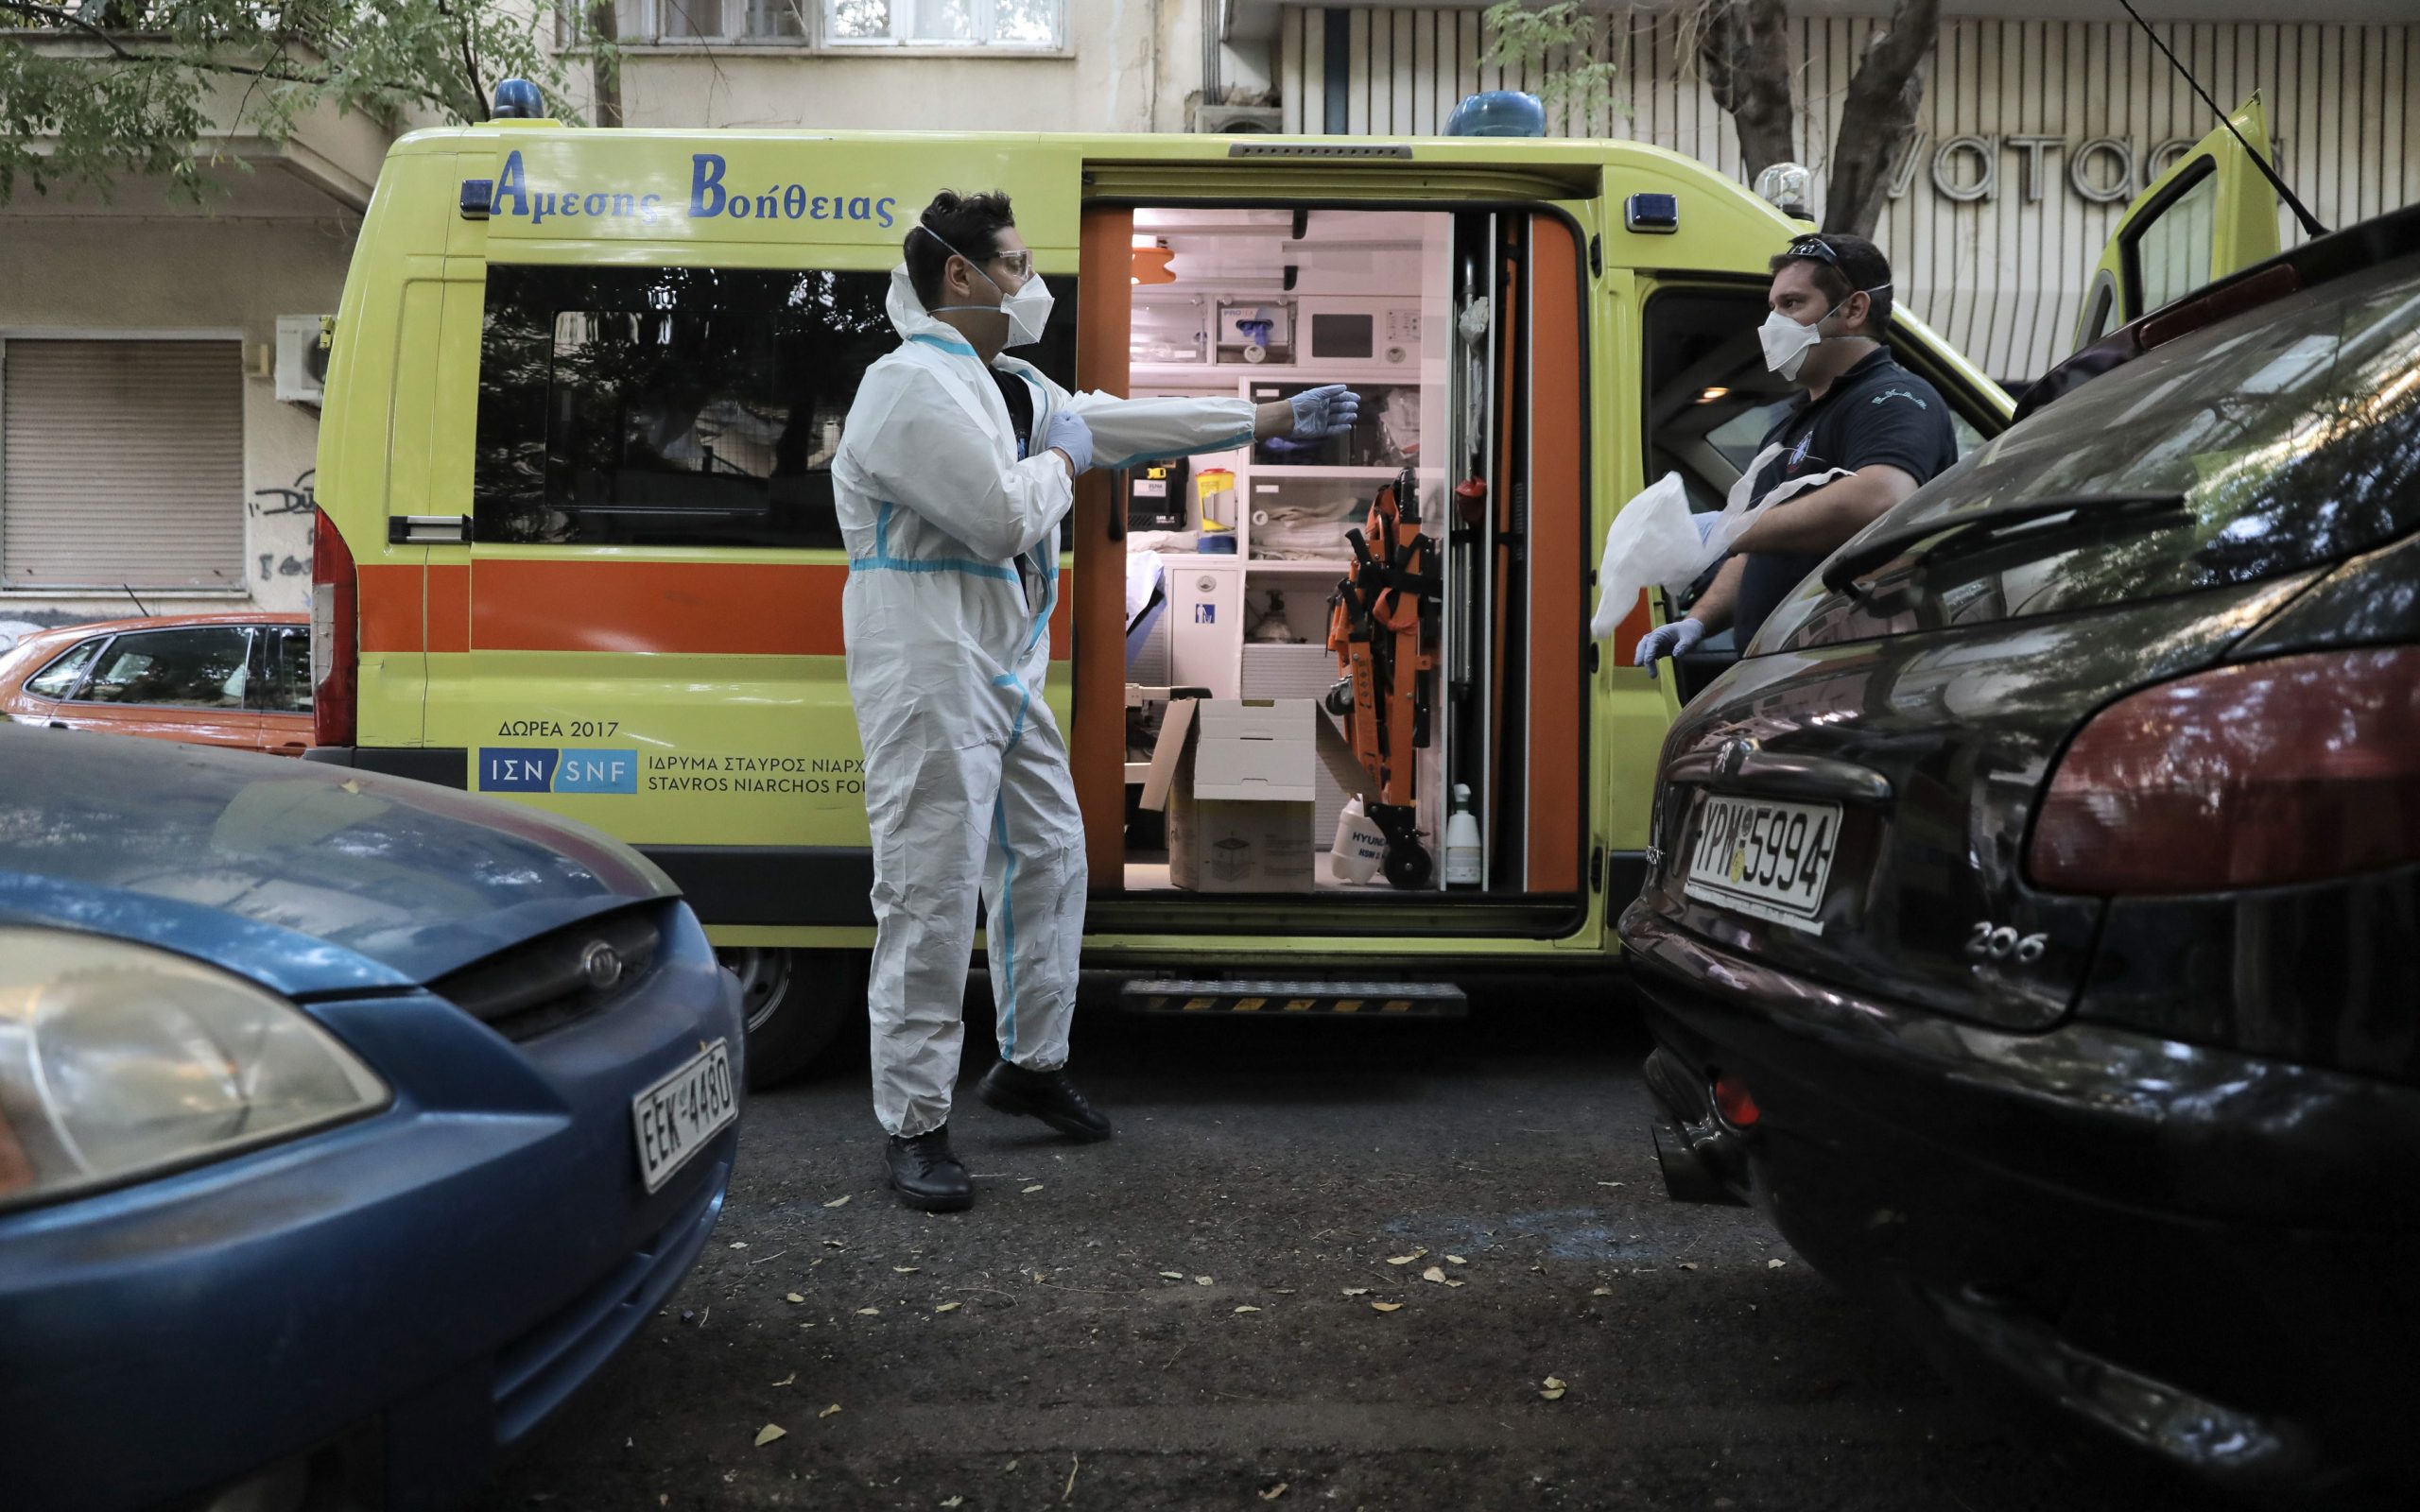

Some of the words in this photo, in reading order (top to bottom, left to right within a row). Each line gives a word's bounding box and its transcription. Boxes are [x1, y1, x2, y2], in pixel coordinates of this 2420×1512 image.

[491, 149, 661, 225] Αμεσης
[688, 153, 896, 228] Βοήθειας
[498, 720, 563, 737] ΔΩΡΕΑ
[570, 721, 619, 737] 2017
[492, 759, 544, 782] ΙΣΝ
[565, 760, 626, 782] SNF
[648, 755, 718, 771] ΙΔΡΥΜΑ
[724, 757, 806, 773] ΣΤΑΥΡΟΣ
[648, 776, 728, 792] STAVROS
[735, 778, 830, 794] NIARCHOS
[1966, 921, 2048, 963] 206
